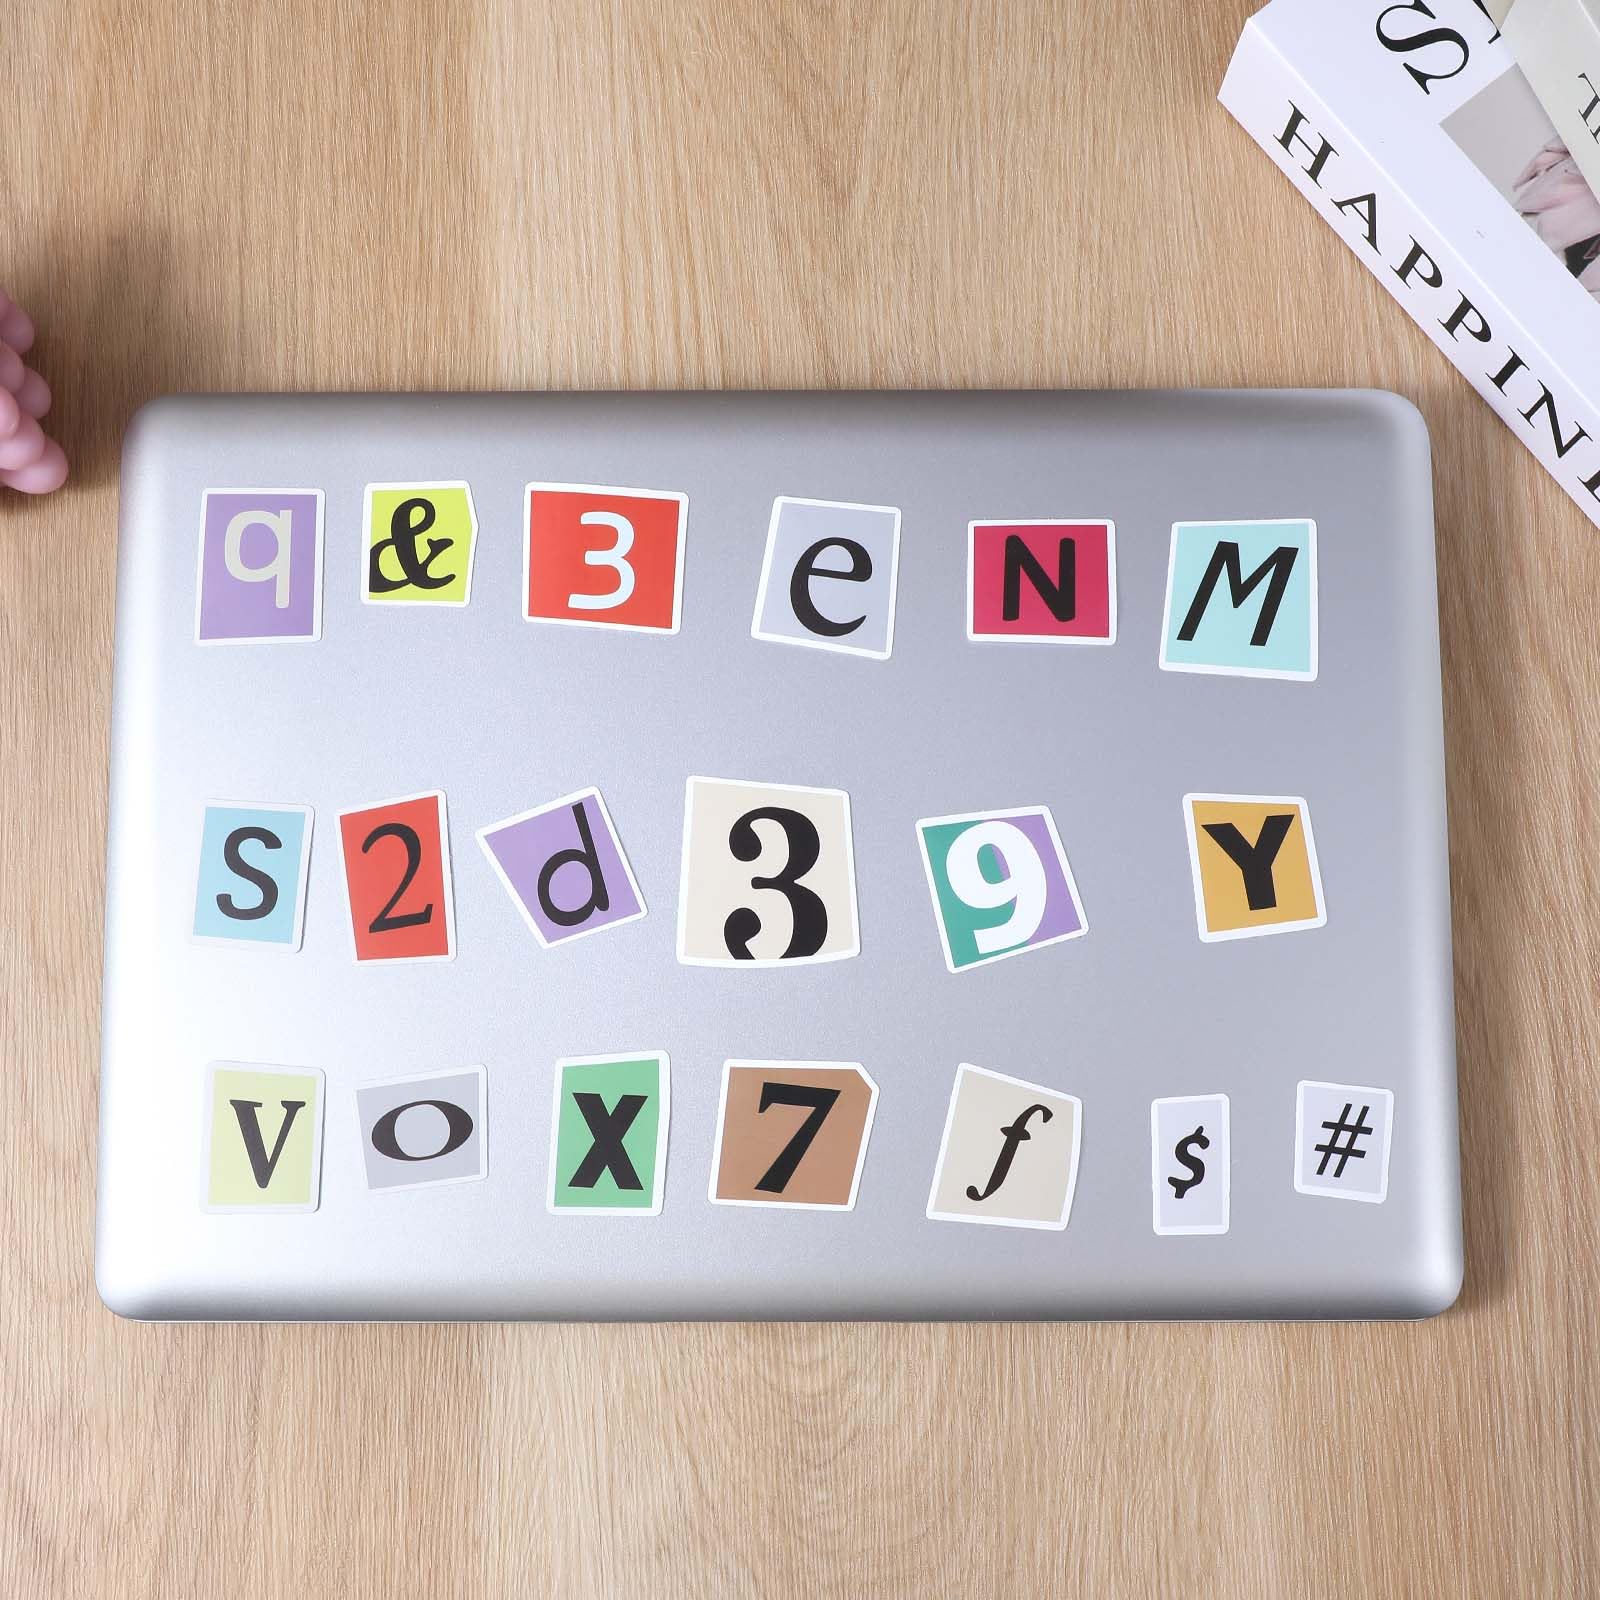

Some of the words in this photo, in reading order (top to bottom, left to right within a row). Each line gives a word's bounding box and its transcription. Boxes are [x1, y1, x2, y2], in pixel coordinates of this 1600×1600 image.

[224, 509, 293, 609] q
[368, 497, 456, 593] &
[567, 511, 636, 610] 3
[789, 537, 873, 637] e
[1002, 534, 1076, 623] N
[1176, 540, 1299, 647] M
[362, 823, 434, 934] 2
[537, 802, 610, 927] d
[723, 806, 828, 960] 3
[945, 820, 1048, 955] 9
[1201, 814, 1295, 911] Y
[754, 1081, 842, 1194] 7
[966, 1103, 1054, 1202] f
[1167, 1125, 1210, 1199] $
[1314, 1103, 1374, 1178] #
